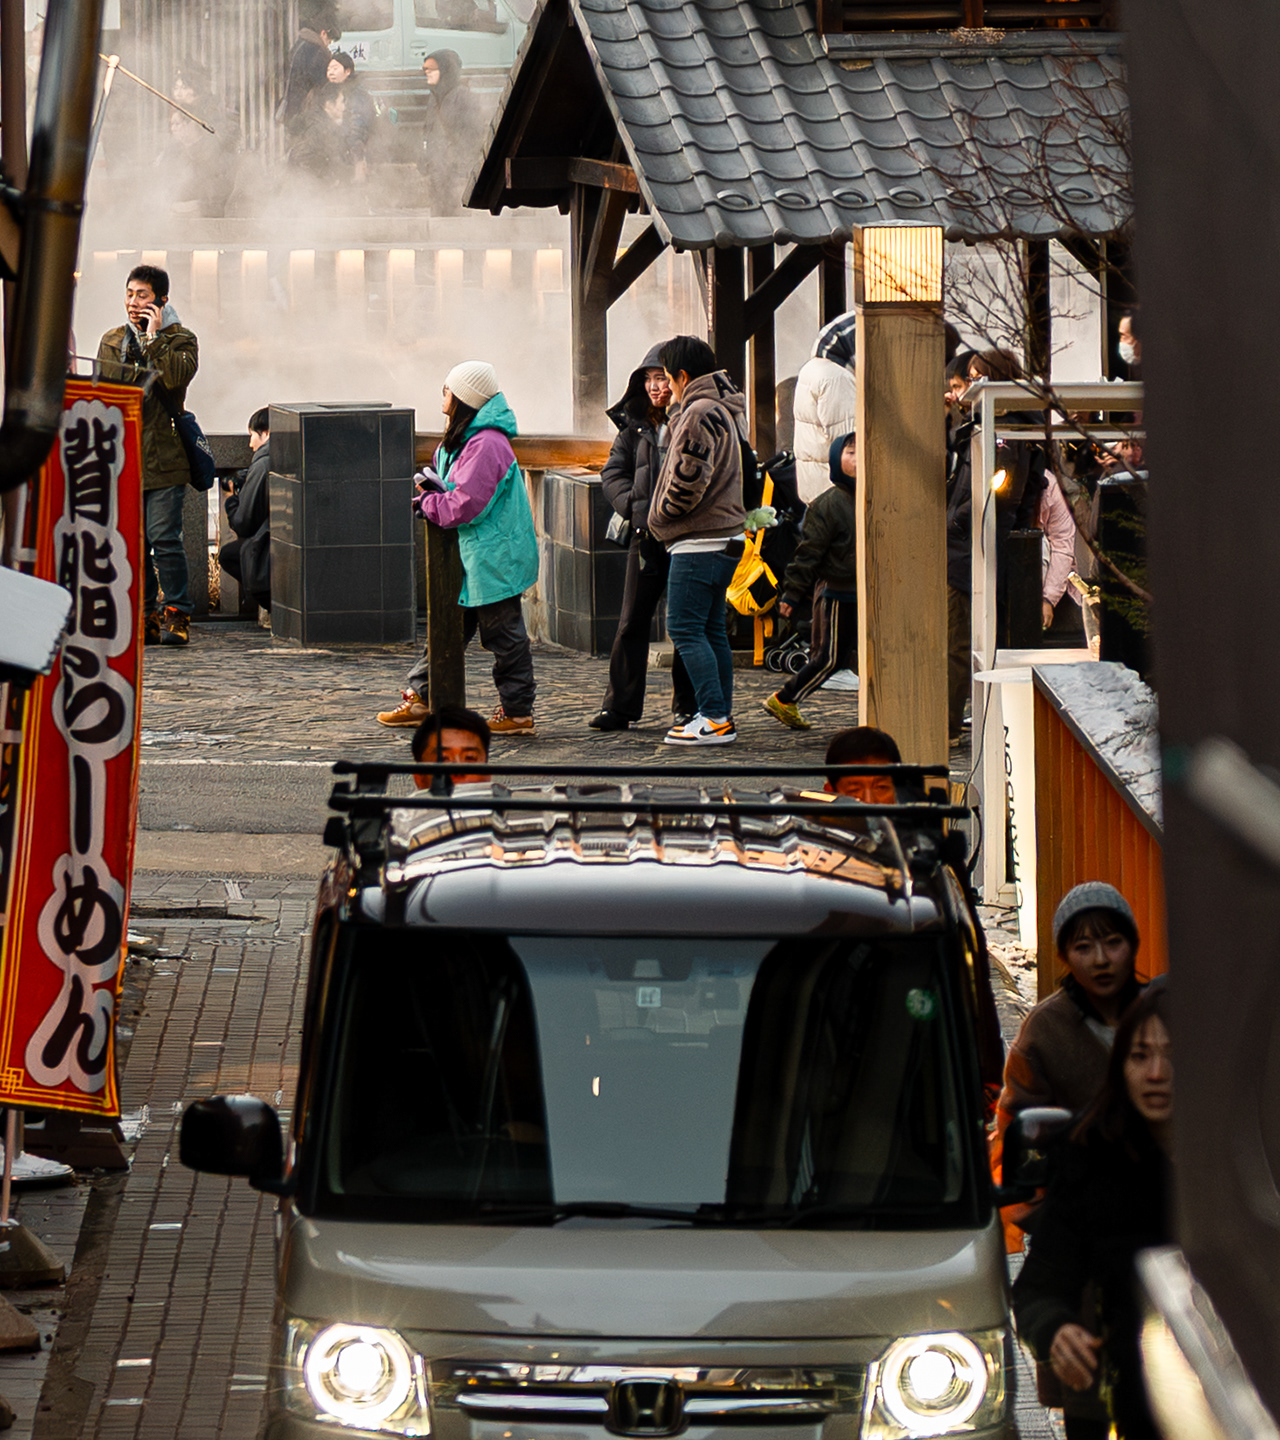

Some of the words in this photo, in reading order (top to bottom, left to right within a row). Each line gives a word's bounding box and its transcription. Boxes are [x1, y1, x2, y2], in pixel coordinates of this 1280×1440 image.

[43, 416, 125, 1068] 背脂らーめん
